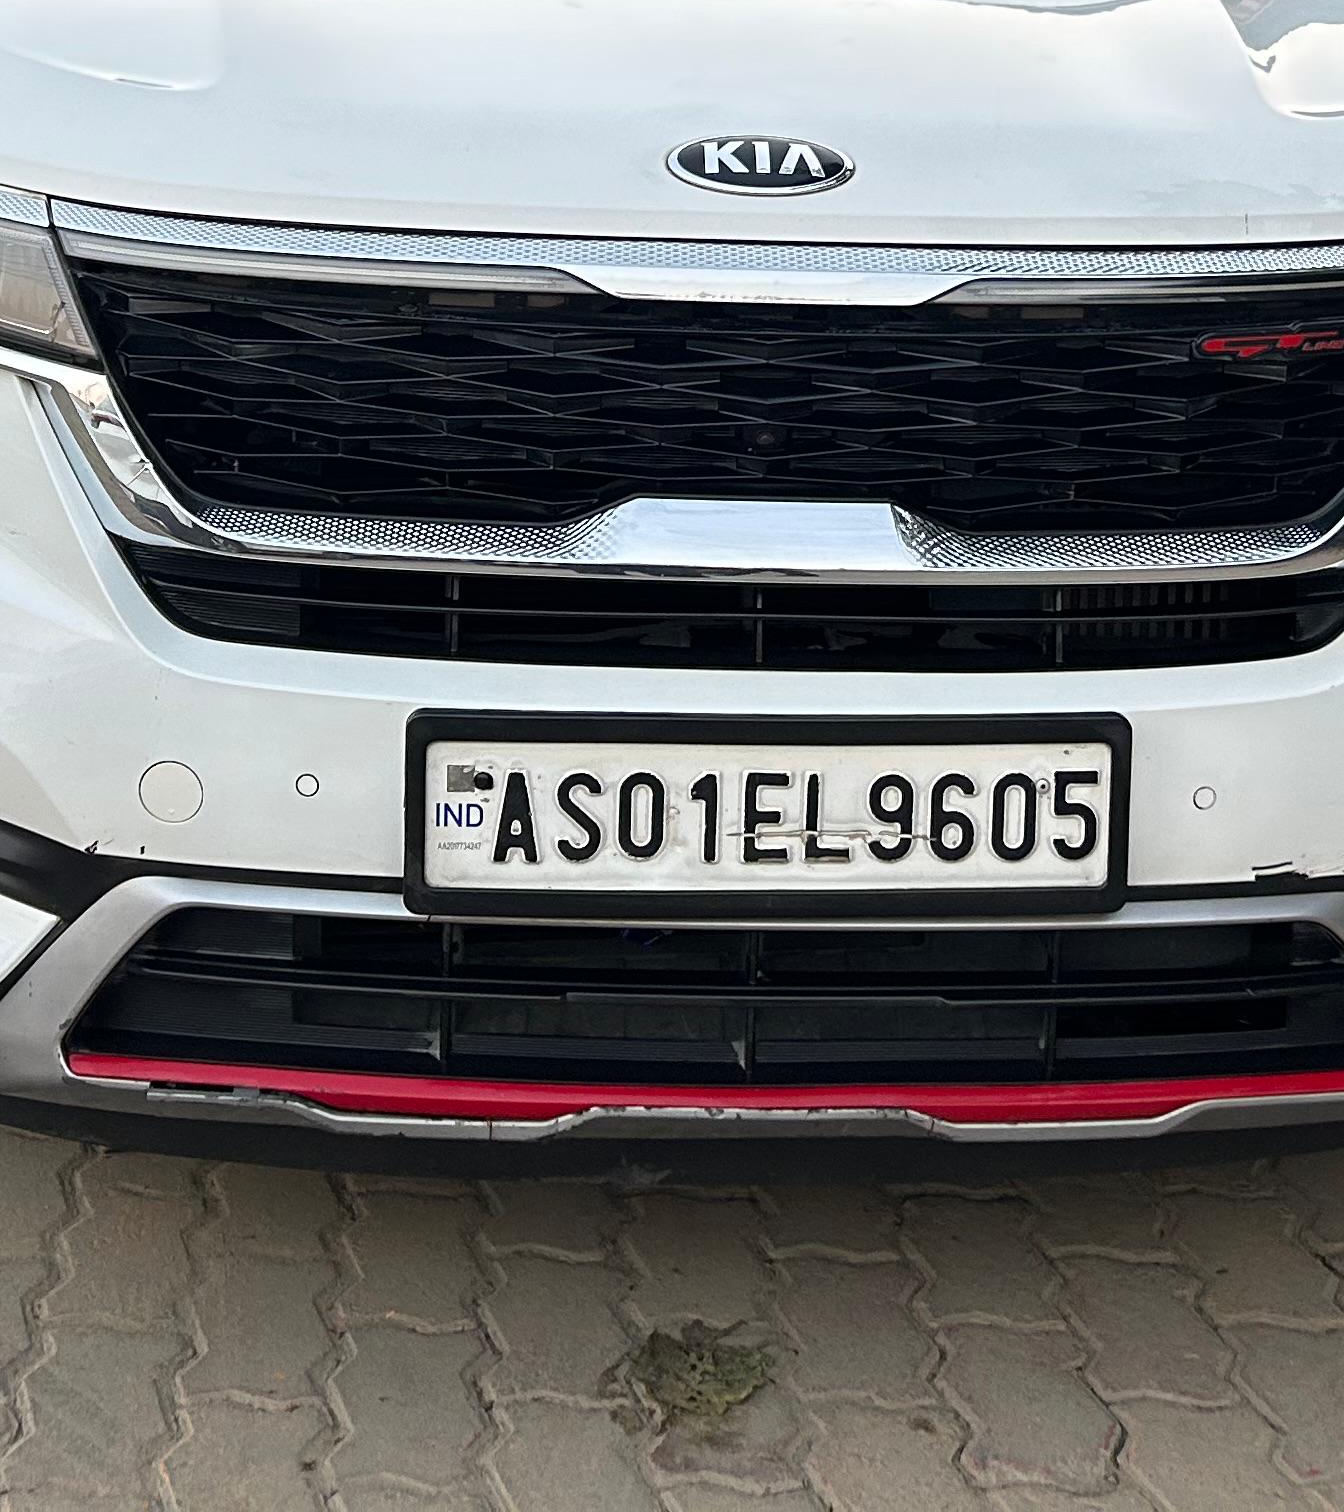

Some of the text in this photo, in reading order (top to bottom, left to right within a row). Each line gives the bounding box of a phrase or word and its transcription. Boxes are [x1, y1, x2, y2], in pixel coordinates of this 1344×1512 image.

[701, 141, 826, 178] KIA
[435, 803, 484, 828] IND
[492, 771, 1099, 863] AS01EL9605
